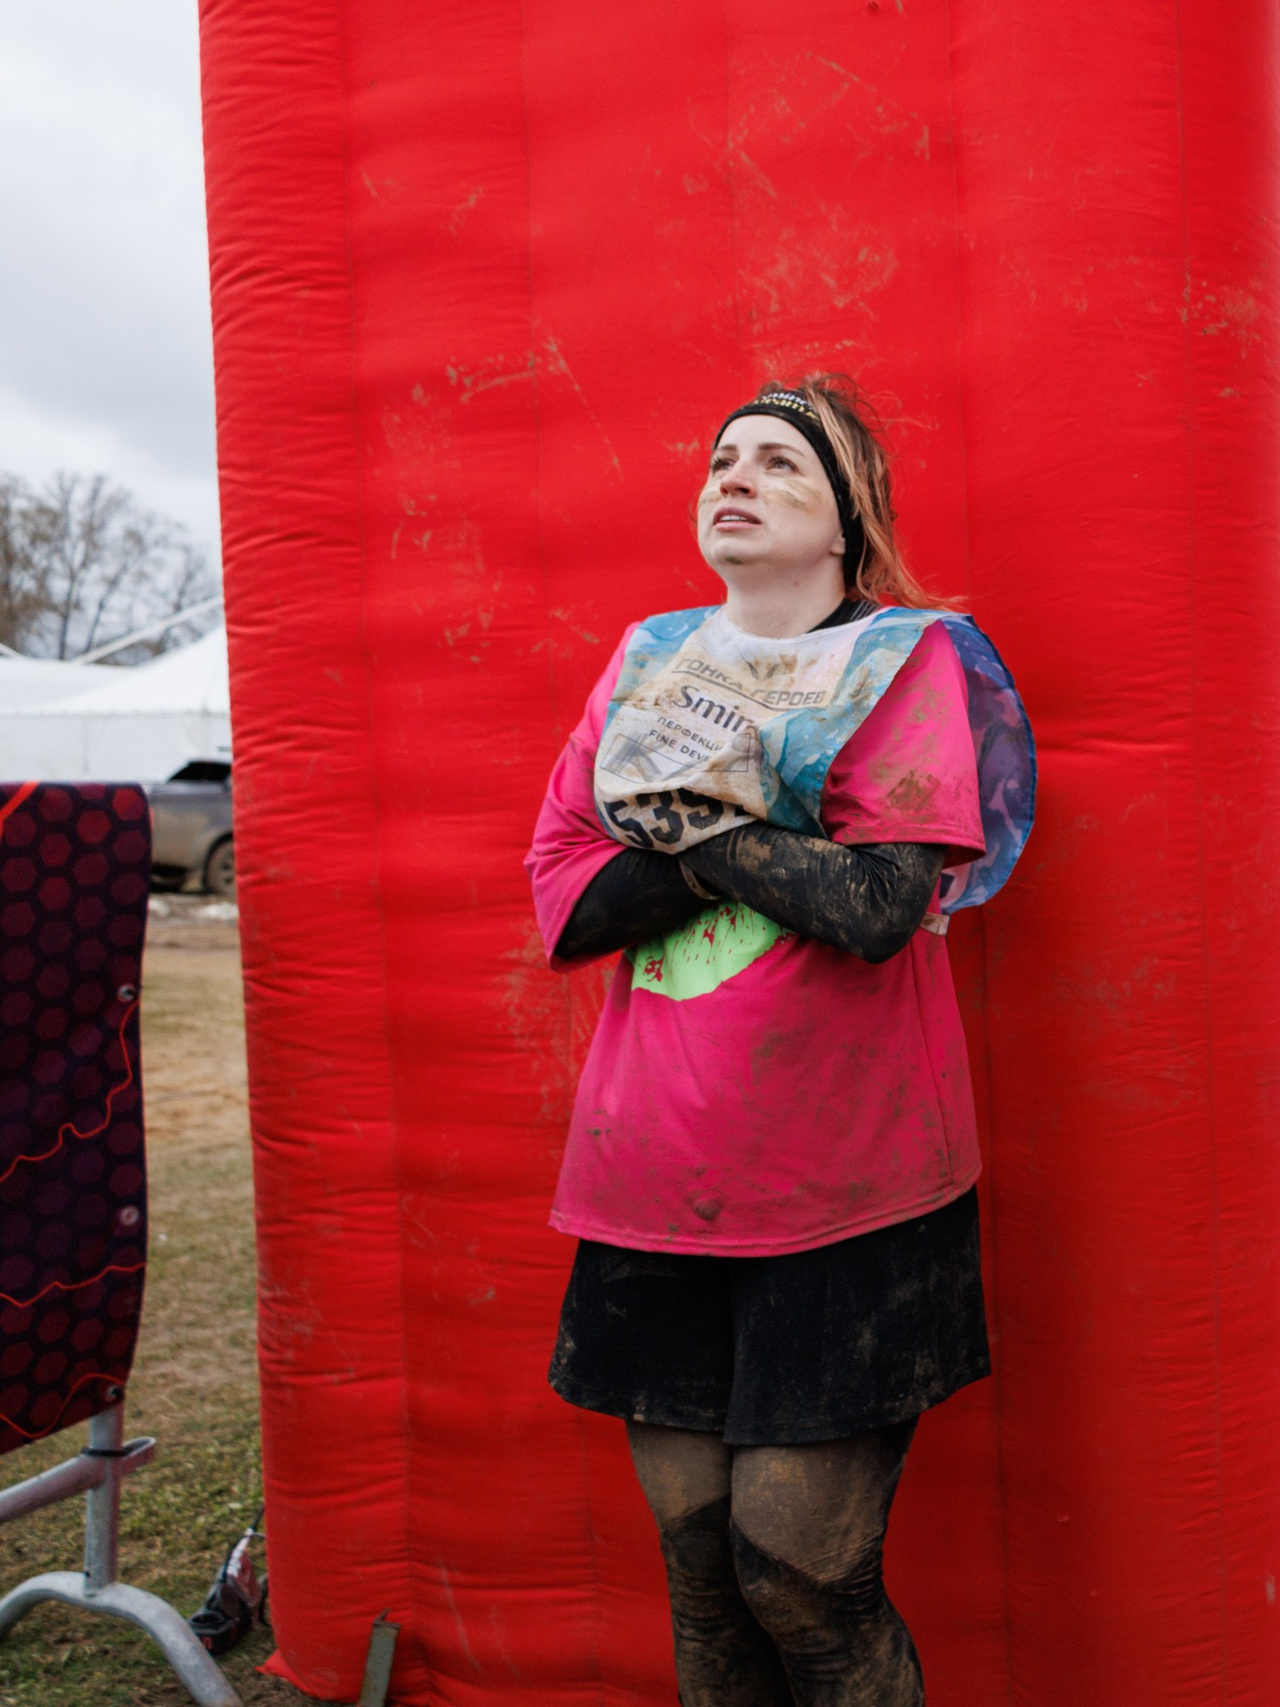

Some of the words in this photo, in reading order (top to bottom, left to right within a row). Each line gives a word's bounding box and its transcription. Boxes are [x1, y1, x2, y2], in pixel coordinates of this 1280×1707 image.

[675, 658, 744, 691] ГОНКА
[750, 688, 828, 707] ГЕРОЕВ
[648, 729, 676, 749] FINE
[603, 788, 750, 849] 539
